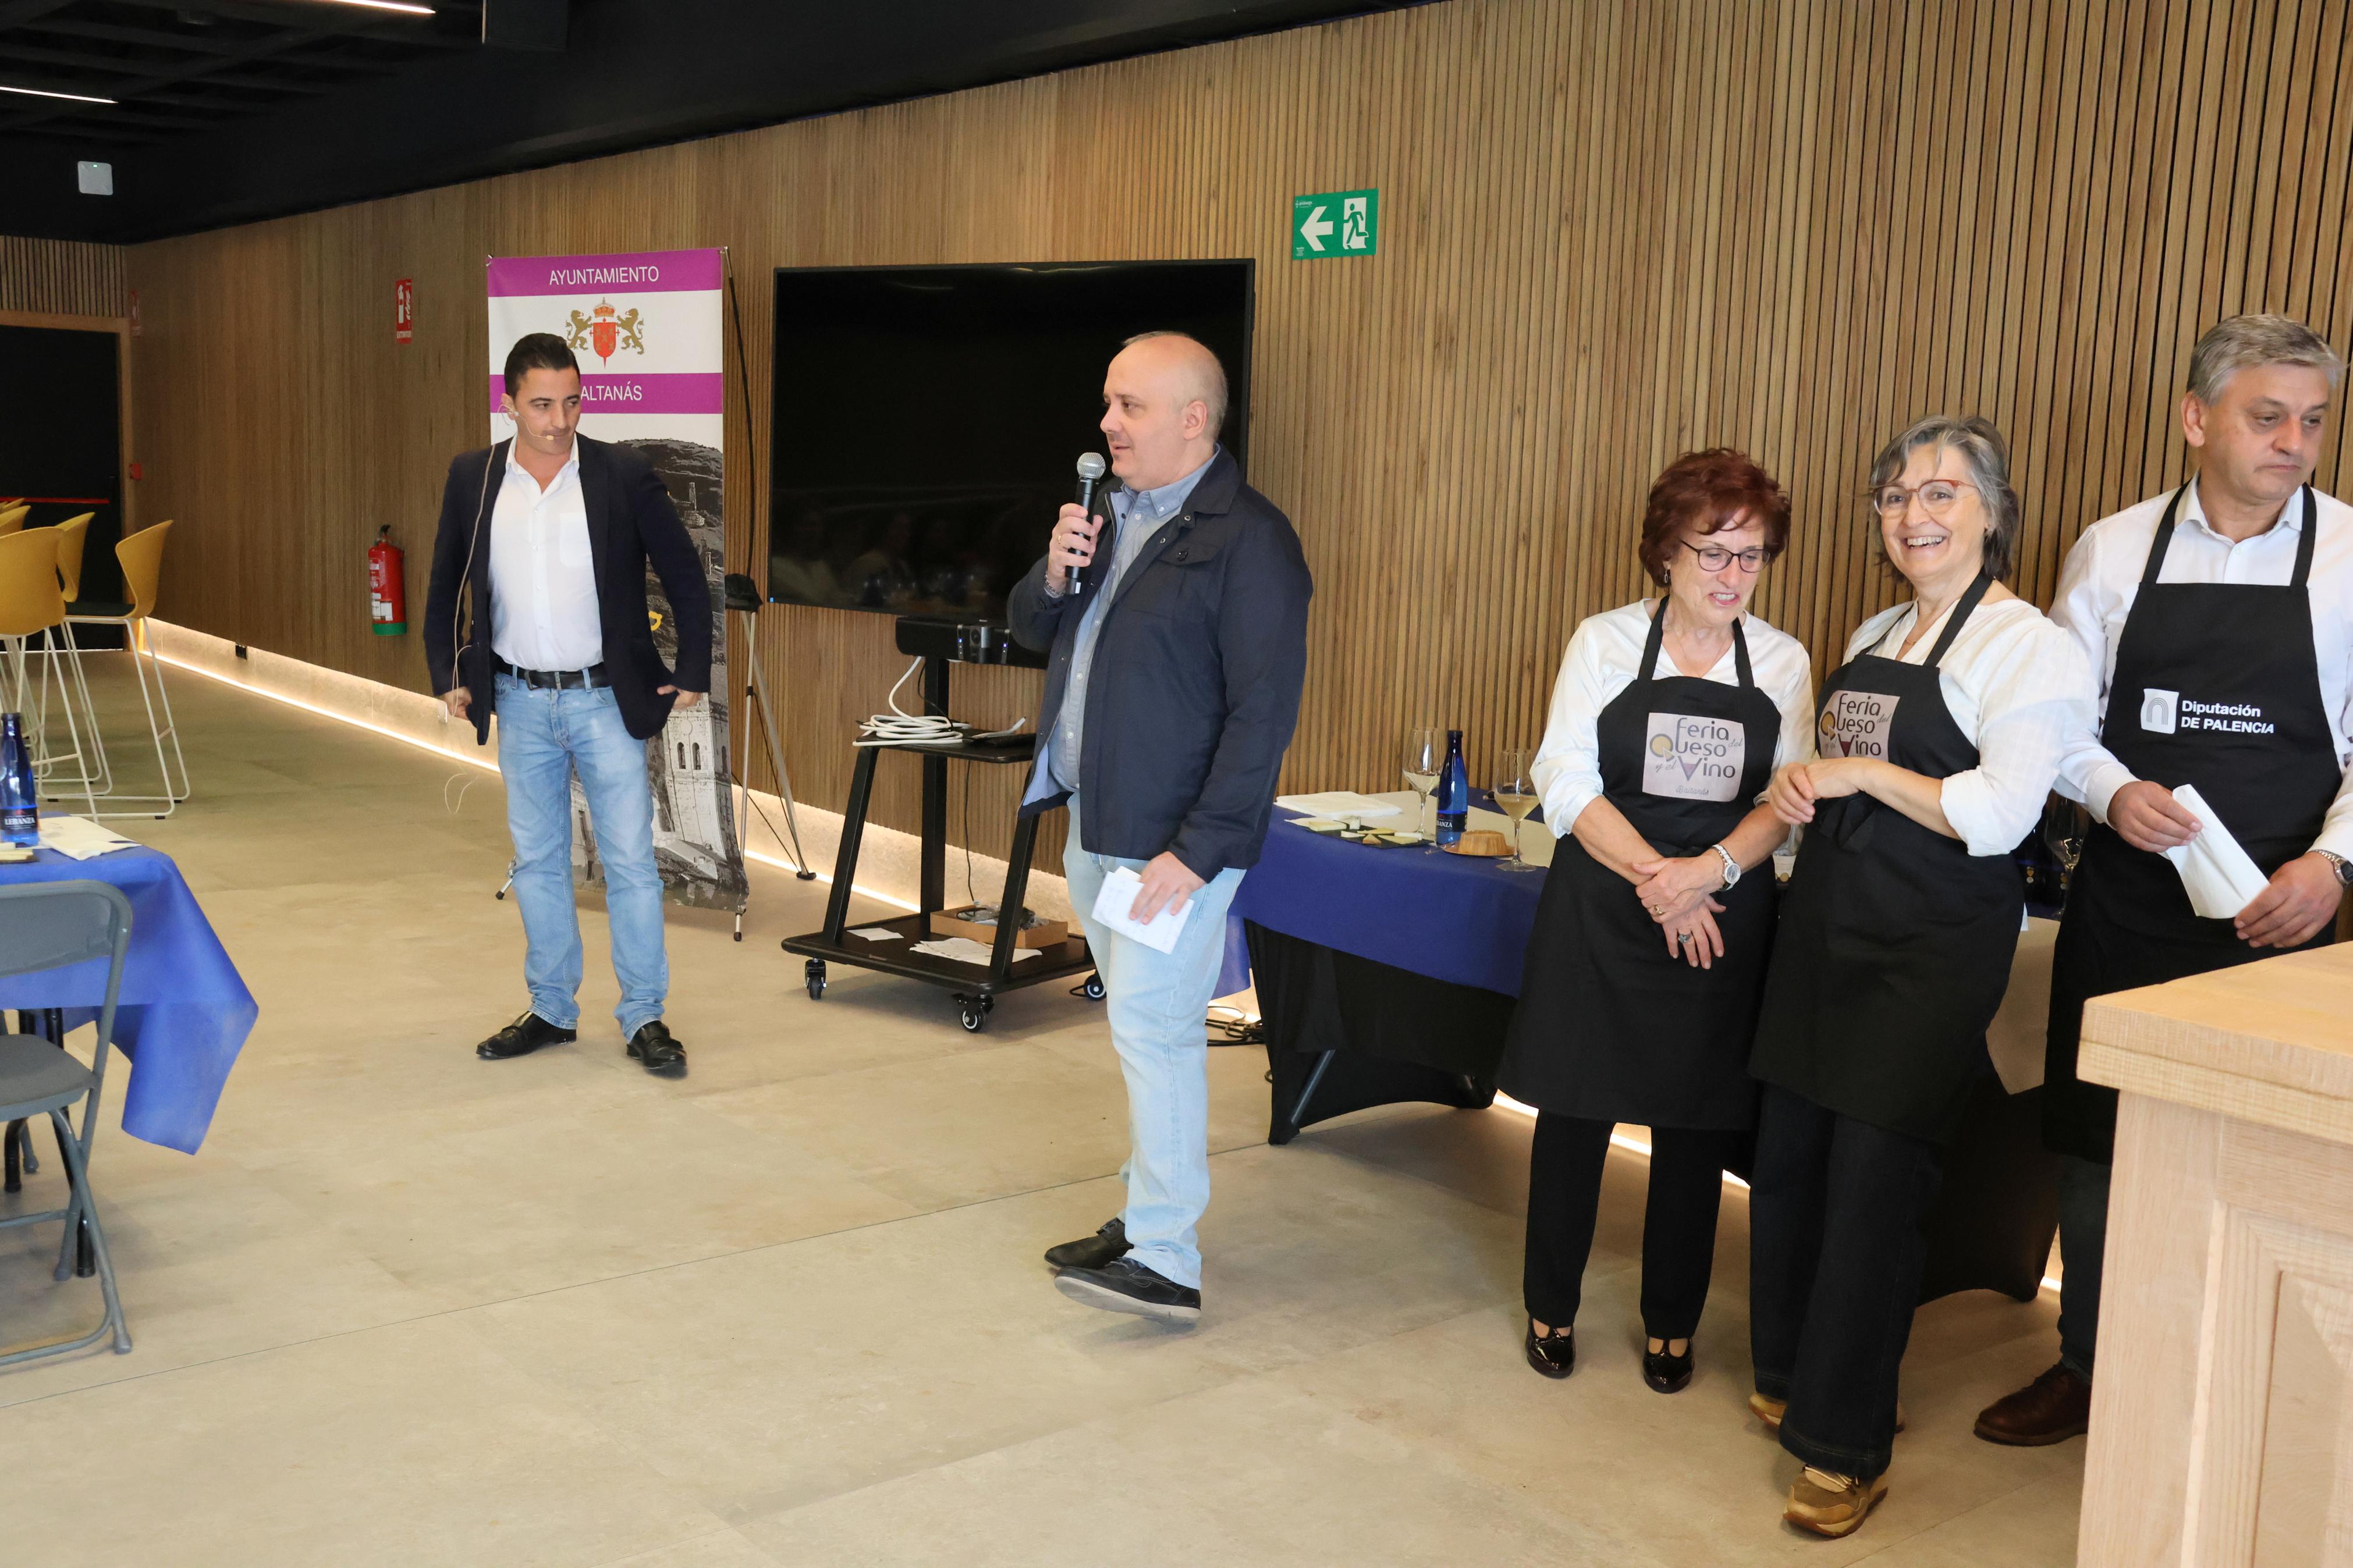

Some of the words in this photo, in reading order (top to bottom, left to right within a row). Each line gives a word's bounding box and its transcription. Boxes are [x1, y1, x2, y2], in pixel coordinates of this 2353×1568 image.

[549, 266, 659, 285] AYUNTAMIENTO
[580, 381, 643, 401] ALTANÁS
[2182, 700, 2261, 717] Diputación
[2181, 716, 2201, 729] DE
[2203, 719, 2274, 734] PALENCIA
[1728, 738, 1743, 748] del
[1837, 734, 1882, 758] Vino
[1677, 755, 1736, 781] Vino
